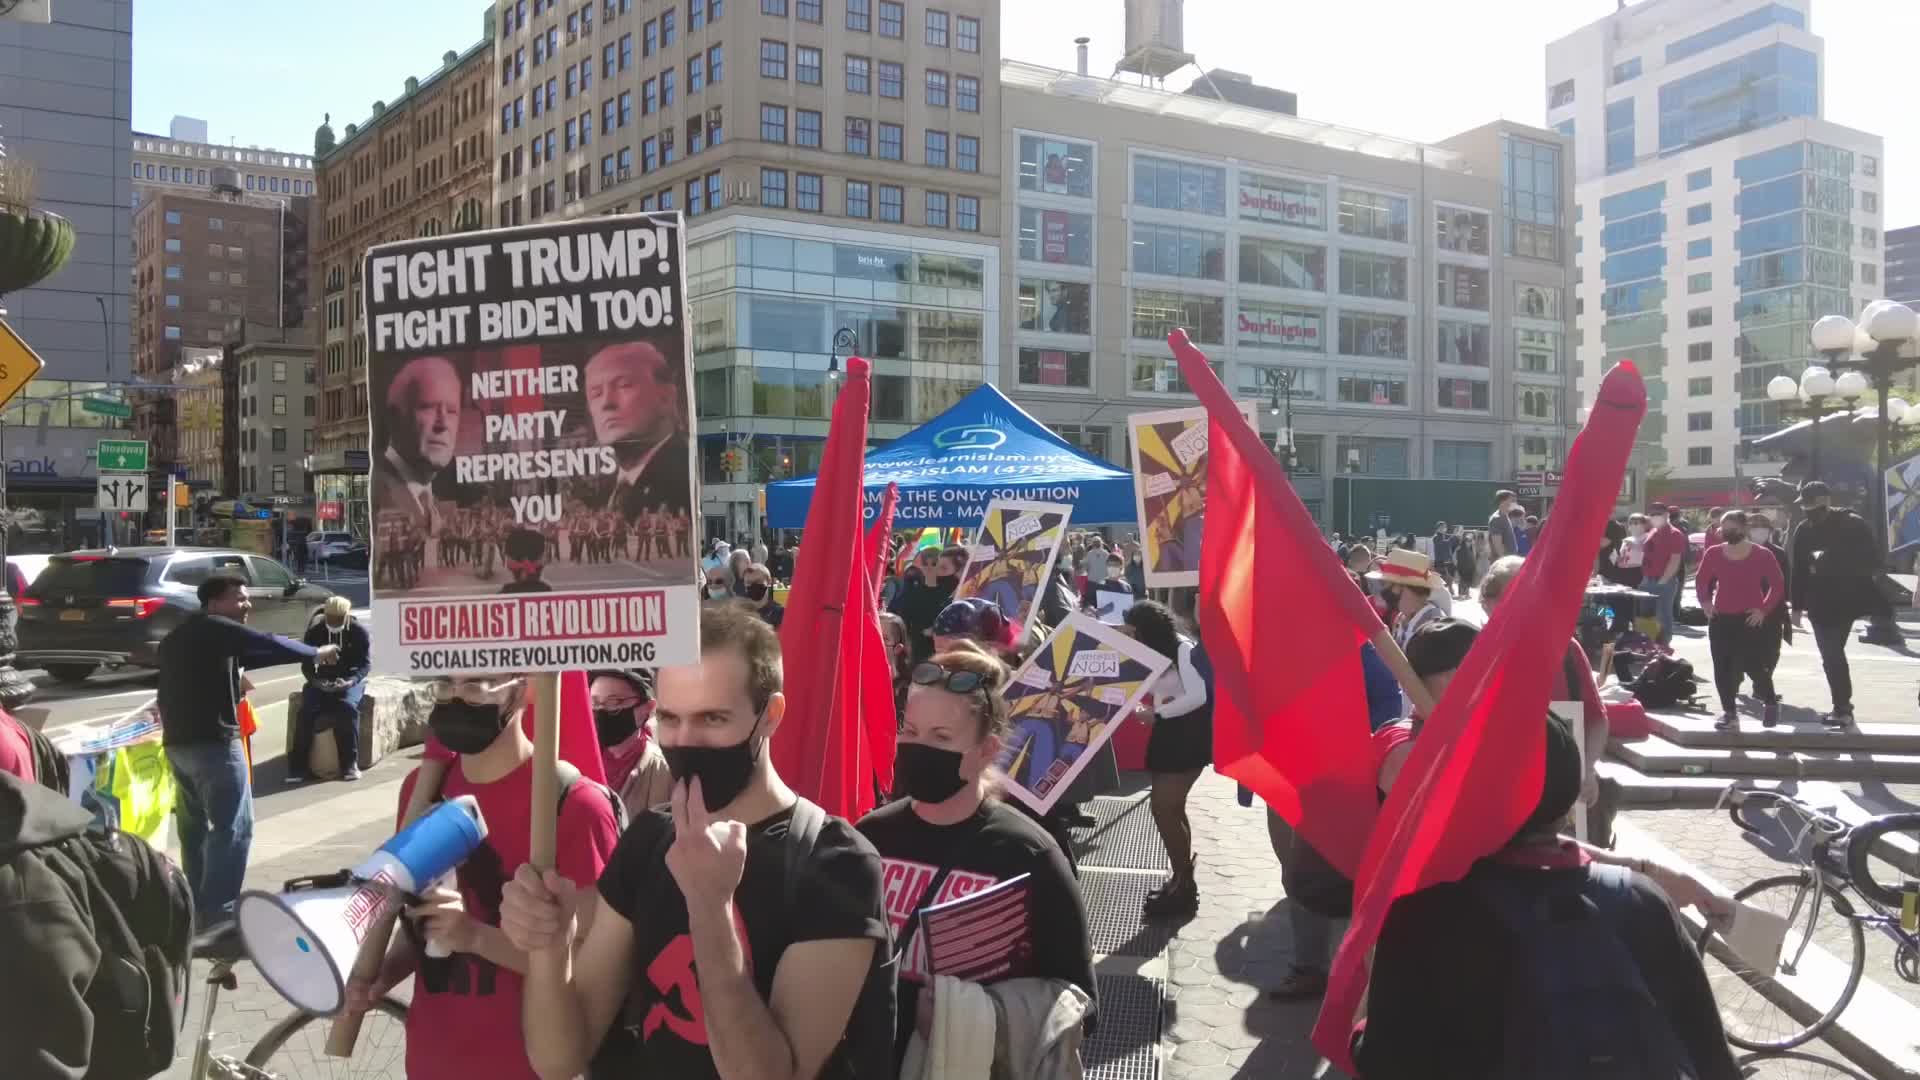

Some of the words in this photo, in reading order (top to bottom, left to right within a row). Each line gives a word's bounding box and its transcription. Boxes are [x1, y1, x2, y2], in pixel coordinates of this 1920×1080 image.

[372, 244, 492, 302] FIGHT
[502, 226, 671, 288] TRUMP!
[375, 305, 471, 351] FIGHT
[479, 294, 583, 342] BIDEN
[589, 286, 673, 331] TOO!
[471, 364, 579, 400] NEITHER
[485, 410, 567, 442] PARTY
[6, 456, 57, 472] ank
[455, 446, 617, 483] REPRESENTS
[510, 493, 562, 524] YOU
[908, 489, 937, 503] THE
[942, 489, 987, 502] ONLY
[992, 487, 1080, 501] SOLUTION
[881, 506, 942, 519] ACISM
[404, 602, 516, 640] SOCIALIST
[524, 595, 662, 637] REVOLUTION
[410, 642, 656, 669] SOCIALISTREVOLUTION.ORG
[1072, 660, 1117, 674] NOW
